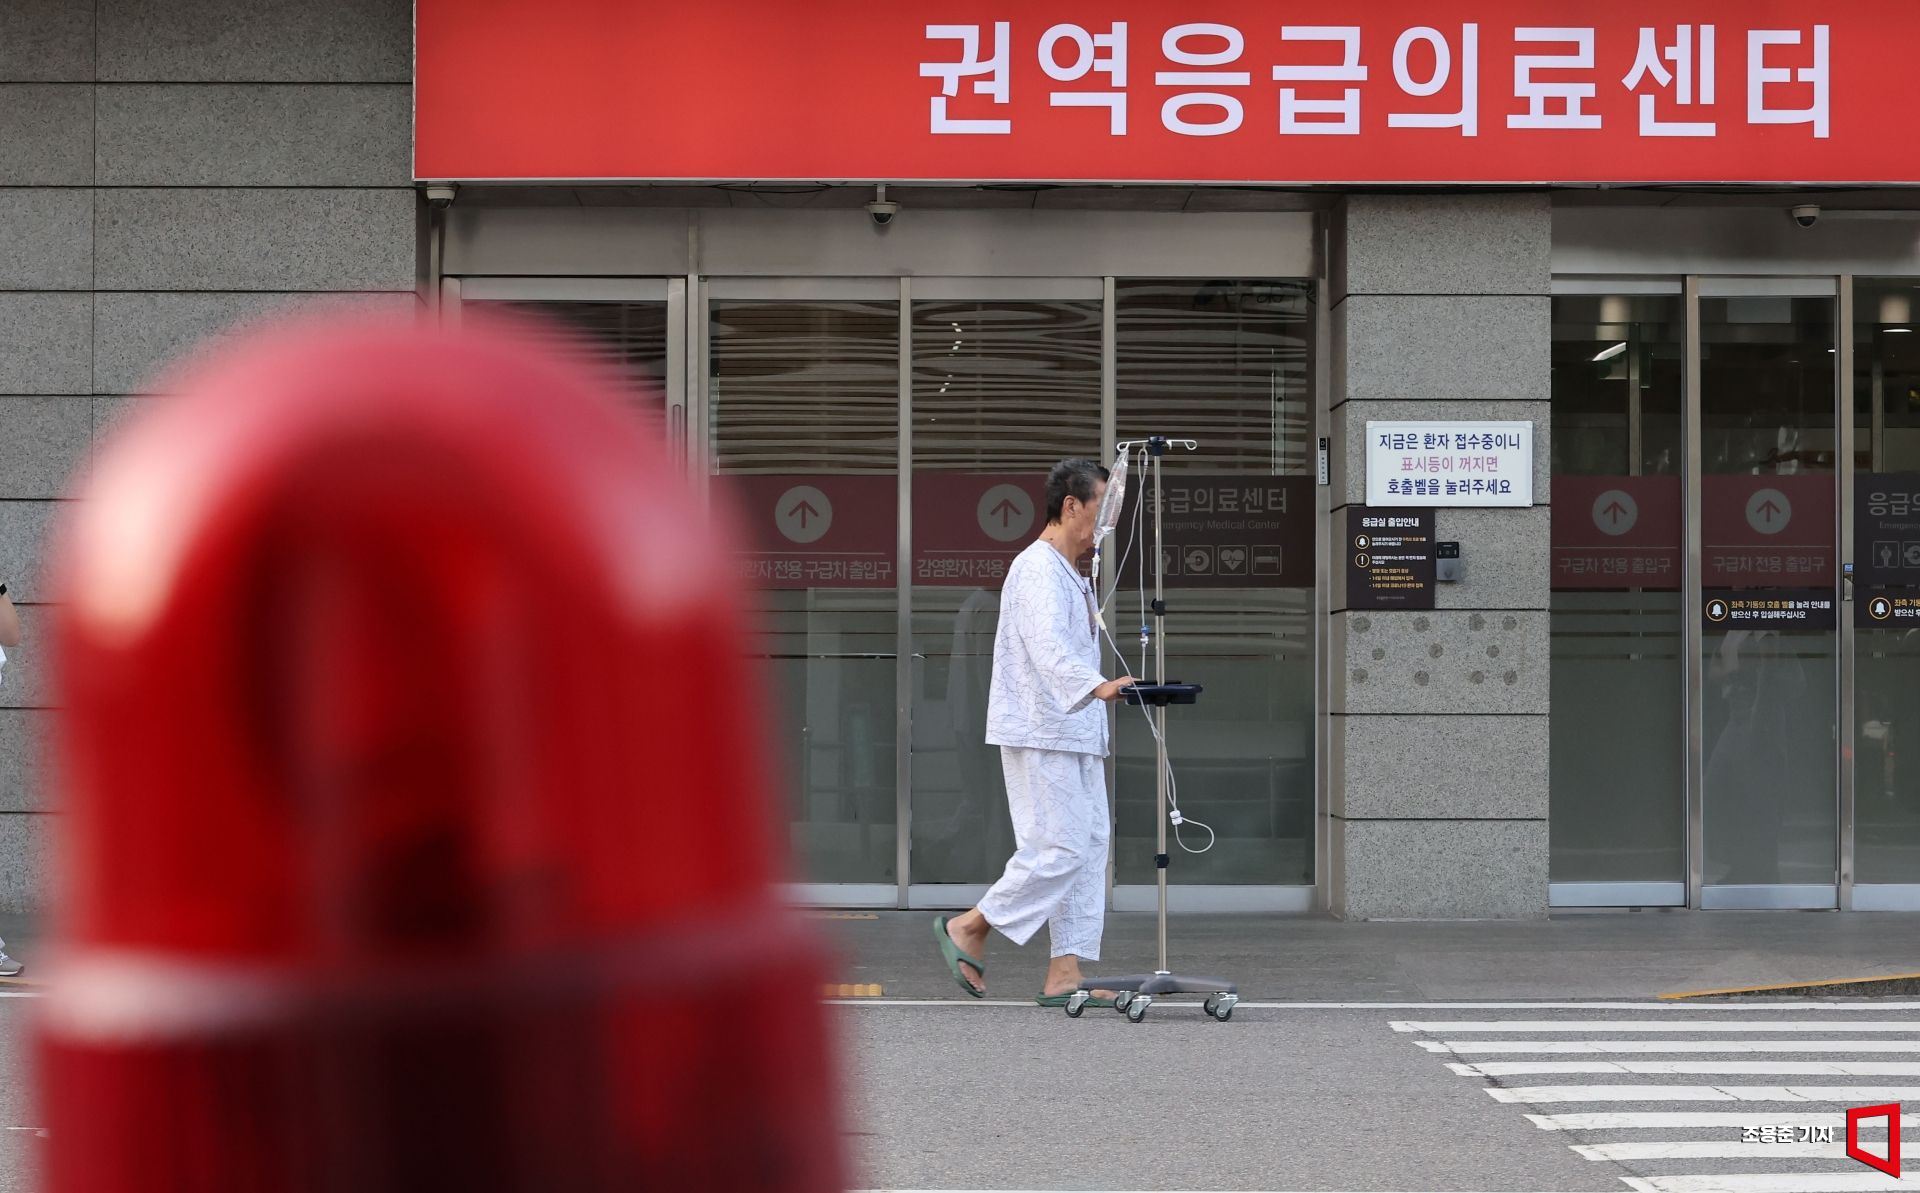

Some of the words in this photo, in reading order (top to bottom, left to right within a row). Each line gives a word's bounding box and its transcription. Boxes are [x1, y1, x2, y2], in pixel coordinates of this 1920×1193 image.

[919, 21, 1830, 138] 권역응급의료센터
[1380, 433, 1419, 450] 지금은
[1423, 433, 1449, 450] 환자
[1454, 433, 1520, 450] 접수중이니
[1401, 455, 1453, 473] 표시등이
[1459, 455, 1498, 473] 꺼지면
[1388, 478, 1441, 495] 호출벨을
[1445, 478, 1512, 495] 눌러주세요
[1144, 487, 1287, 513] 응급의료센터
[1207, 519, 1245, 529] Medical
[1248, 520, 1281, 529] Center
[1362, 517, 1386, 528] 응급실
[1388, 517, 1420, 528] 출입안내
[774, 560, 803, 580] 전용
[805, 560, 847, 580] 구급차
[849, 560, 892, 580] 출입구
[916, 558, 974, 578] 감염환자
[976, 558, 1005, 578] 전용
[1559, 557, 1599, 574] 구급차
[1602, 557, 1628, 574] 전용
[1632, 557, 1671, 574] 출입구
[1712, 556, 1751, 573] 구급차
[1755, 556, 1782, 573] 전용
[1785, 556, 1825, 573] 출입구
[1731, 600, 1744, 609] 좌측
[1746, 600, 1766, 609] 기둥의
[1767, 600, 1780, 609] 호출
[1781, 600, 1795, 609] 벨을
[1796, 600, 1810, 609] 눌러
[1811, 600, 1831, 609] 안내를
[1894, 598, 1908, 607] 좌측
[1731, 610, 1751, 619] 받으신
[1752, 610, 1760, 619] 후
[1761, 610, 1806, 619] 입실해주십시오
[1894, 608, 1914, 617] 받으신
